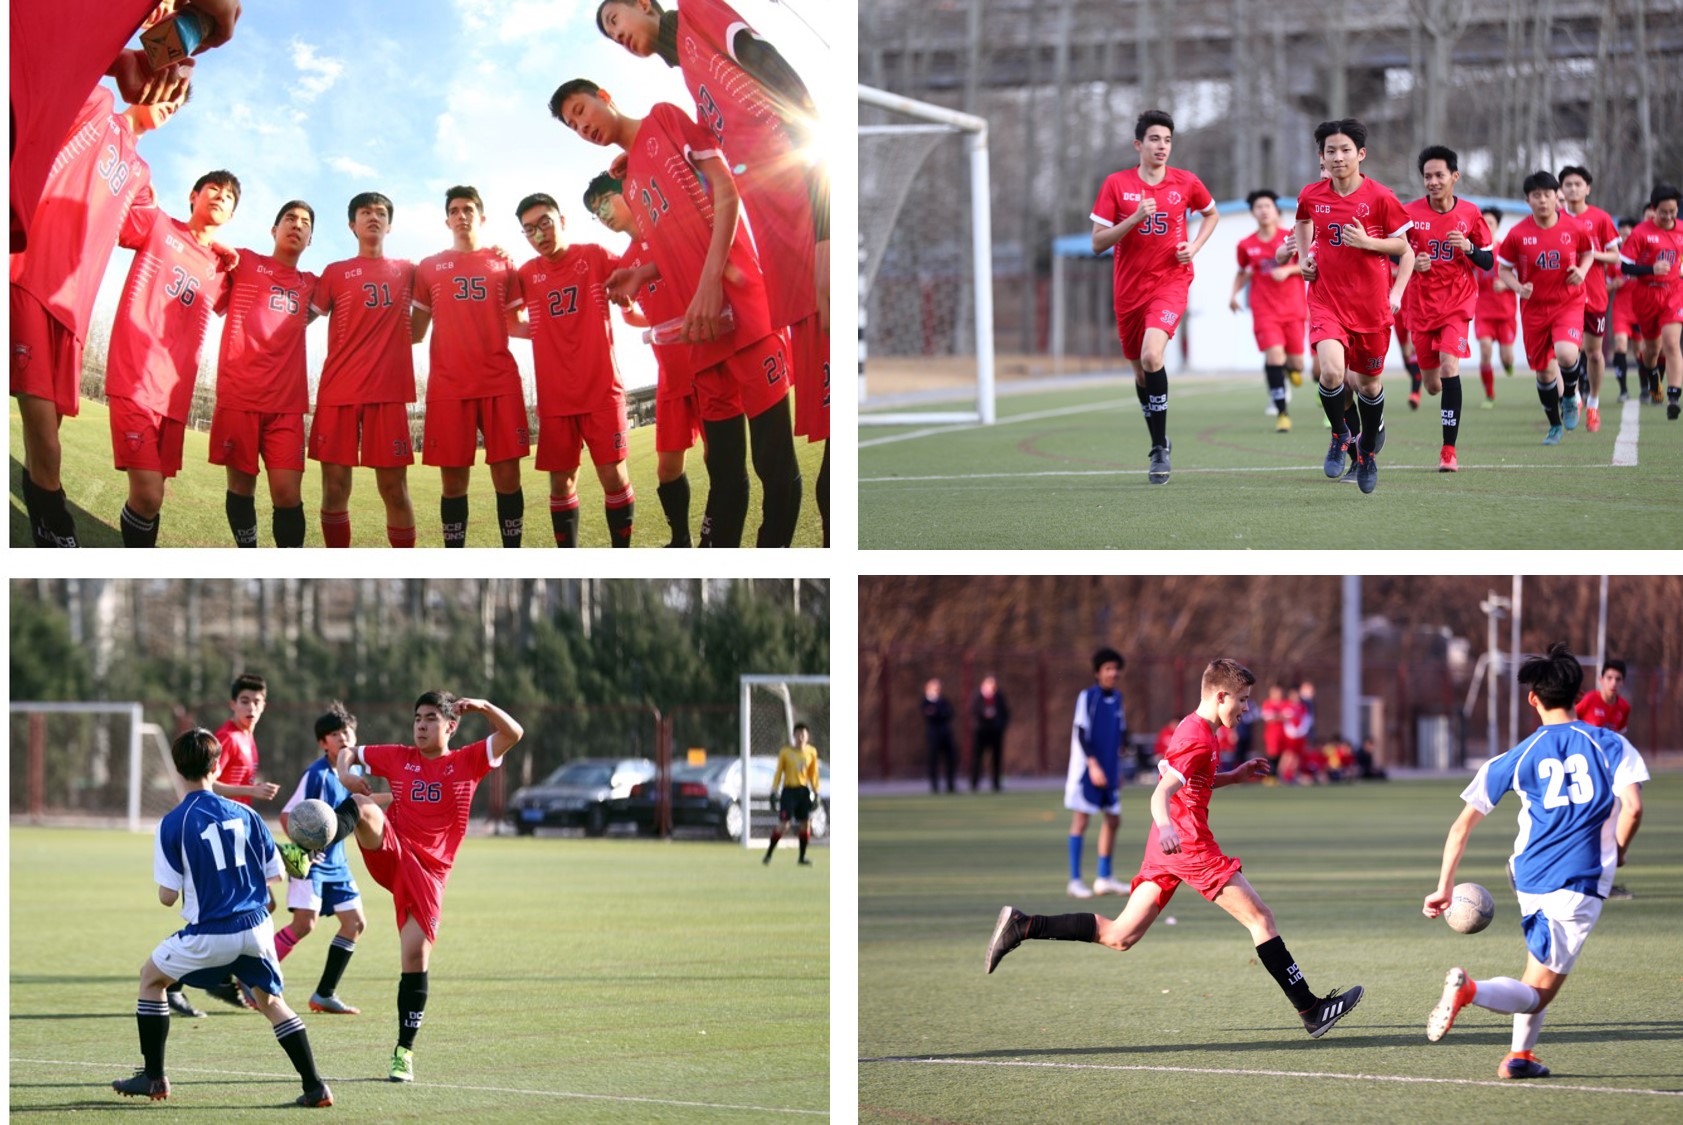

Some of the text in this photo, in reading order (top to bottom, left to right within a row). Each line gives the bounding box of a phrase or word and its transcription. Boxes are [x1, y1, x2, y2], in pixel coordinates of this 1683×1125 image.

[99, 146, 129, 196] 38
[642, 177, 670, 226] 21
[1123, 192, 1141, 202] DCB
[1315, 204, 1331, 214] DCB
[1138, 212, 1168, 235] 35
[1328, 222, 1355, 246] 3
[1414, 221, 1431, 231] DCB
[165, 235, 184, 253] DCB
[1428, 239, 1454, 261] 39
[1523, 236, 1538, 246] DCB
[436, 262, 455, 271] DCB
[1536, 250, 1560, 270] 42
[345, 268, 363, 279] DCB
[165, 267, 199, 306] 36
[363, 282, 394, 309] 31
[453, 276, 487, 301] 35
[269, 286, 299, 315] 26
[547, 284, 579, 318] 27
[1596, 316, 1606, 334] 10
[763, 349, 786, 387] 21
[1148, 401, 1168, 412] LIONS
[1149, 394, 1167, 404] DCB
[404, 763, 421, 773] DCB
[411, 780, 442, 803] 26
[1538, 753, 1594, 810] 23
[200, 818, 247, 871] 17
